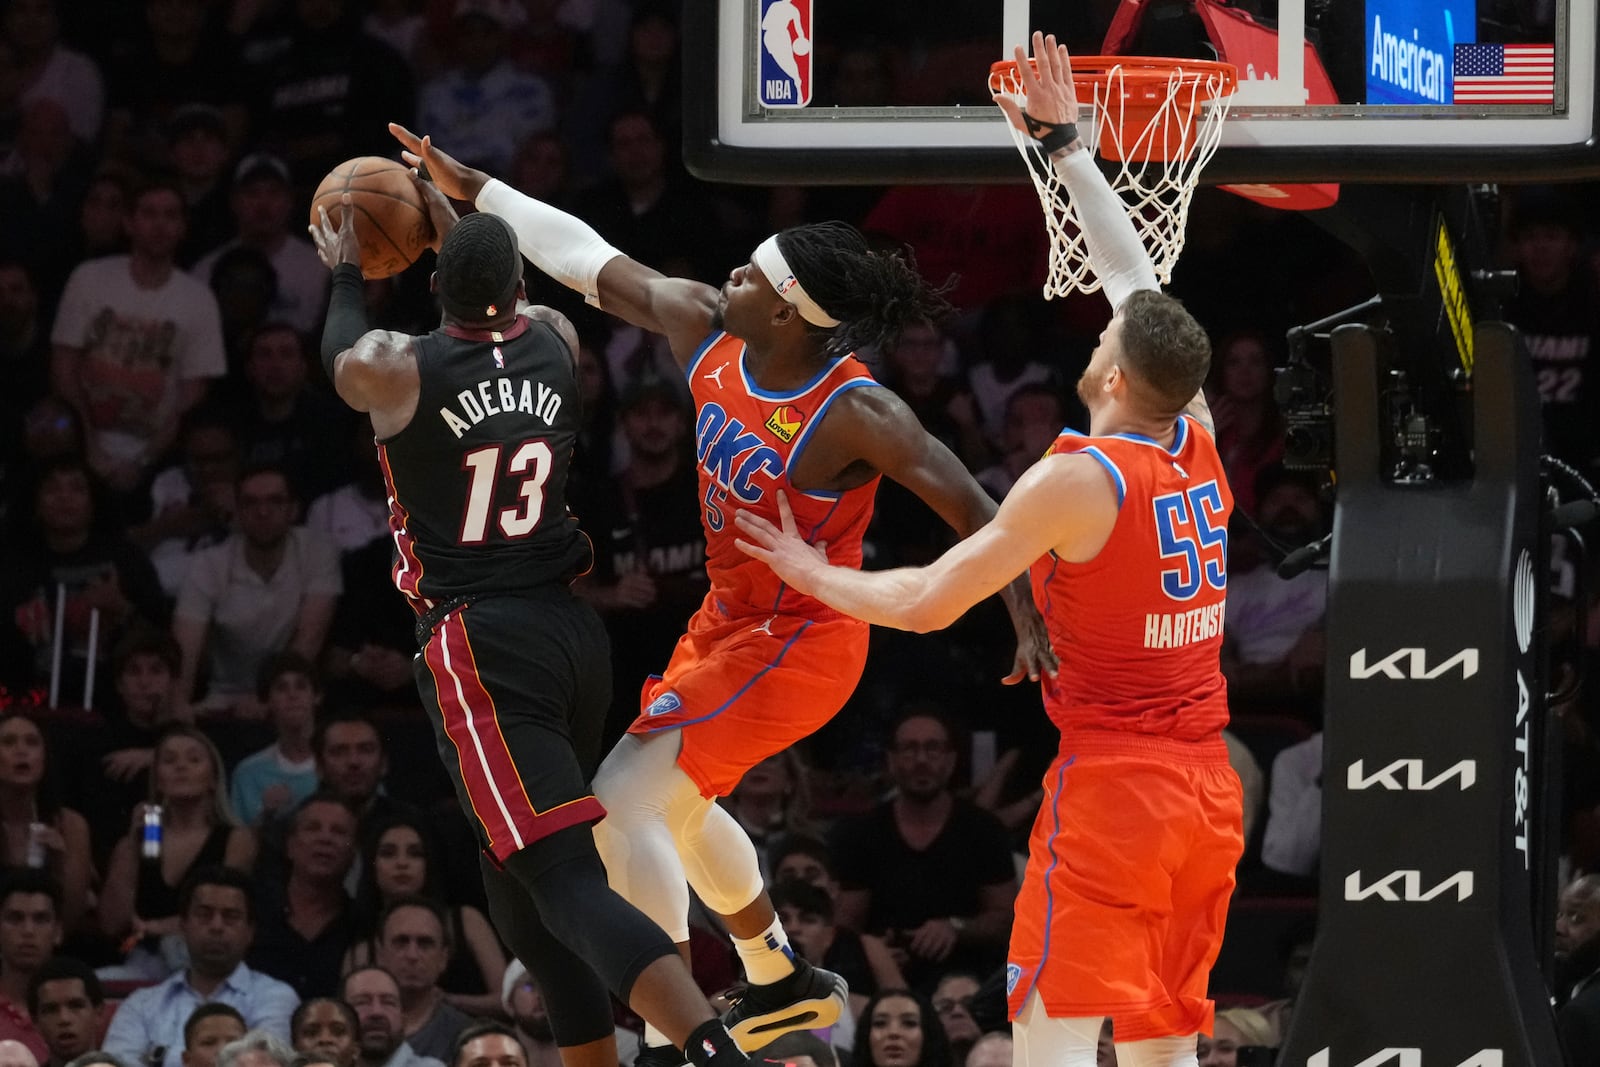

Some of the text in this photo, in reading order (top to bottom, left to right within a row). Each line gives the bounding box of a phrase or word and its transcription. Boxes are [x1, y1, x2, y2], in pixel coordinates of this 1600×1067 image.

[1371, 14, 1445, 104] American
[766, 79, 792, 100] NBA
[440, 377, 562, 439] ADEBAYO
[1537, 367, 1583, 403] 22
[696, 402, 784, 504] OKC
[459, 438, 553, 546] 13
[705, 482, 728, 532] 5
[612, 540, 704, 576] MAMI
[1152, 479, 1228, 601] 55
[1144, 598, 1226, 649] HARTENST
[1350, 648, 1478, 680] KIA
[1347, 759, 1476, 791] KIA
[1515, 669, 1529, 870] AT&T
[1345, 870, 1473, 902] KIA
